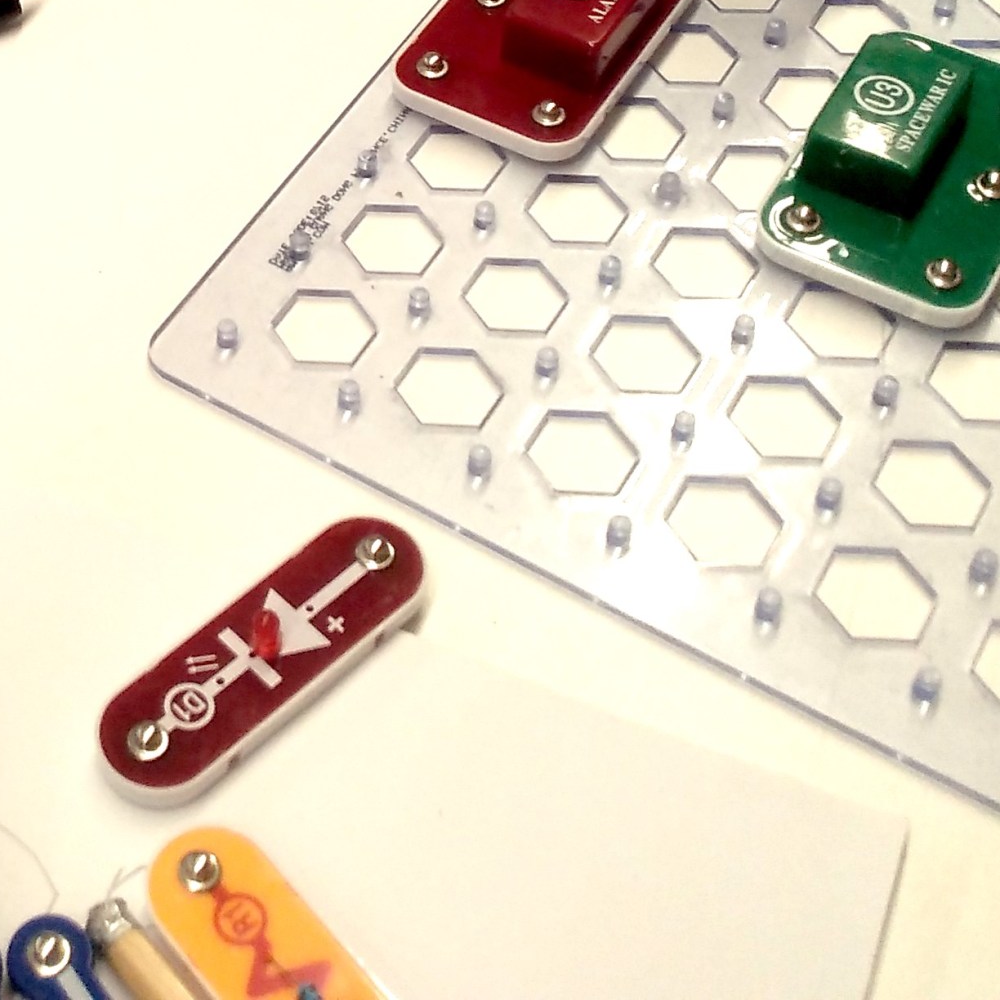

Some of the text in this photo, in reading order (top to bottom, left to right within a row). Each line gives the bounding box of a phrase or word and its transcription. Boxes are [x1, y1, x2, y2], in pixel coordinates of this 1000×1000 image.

[864, 80, 904, 109] U3
[896, 68, 958, 153] SPACEWAR IC
[169, 690, 208, 721] D1
